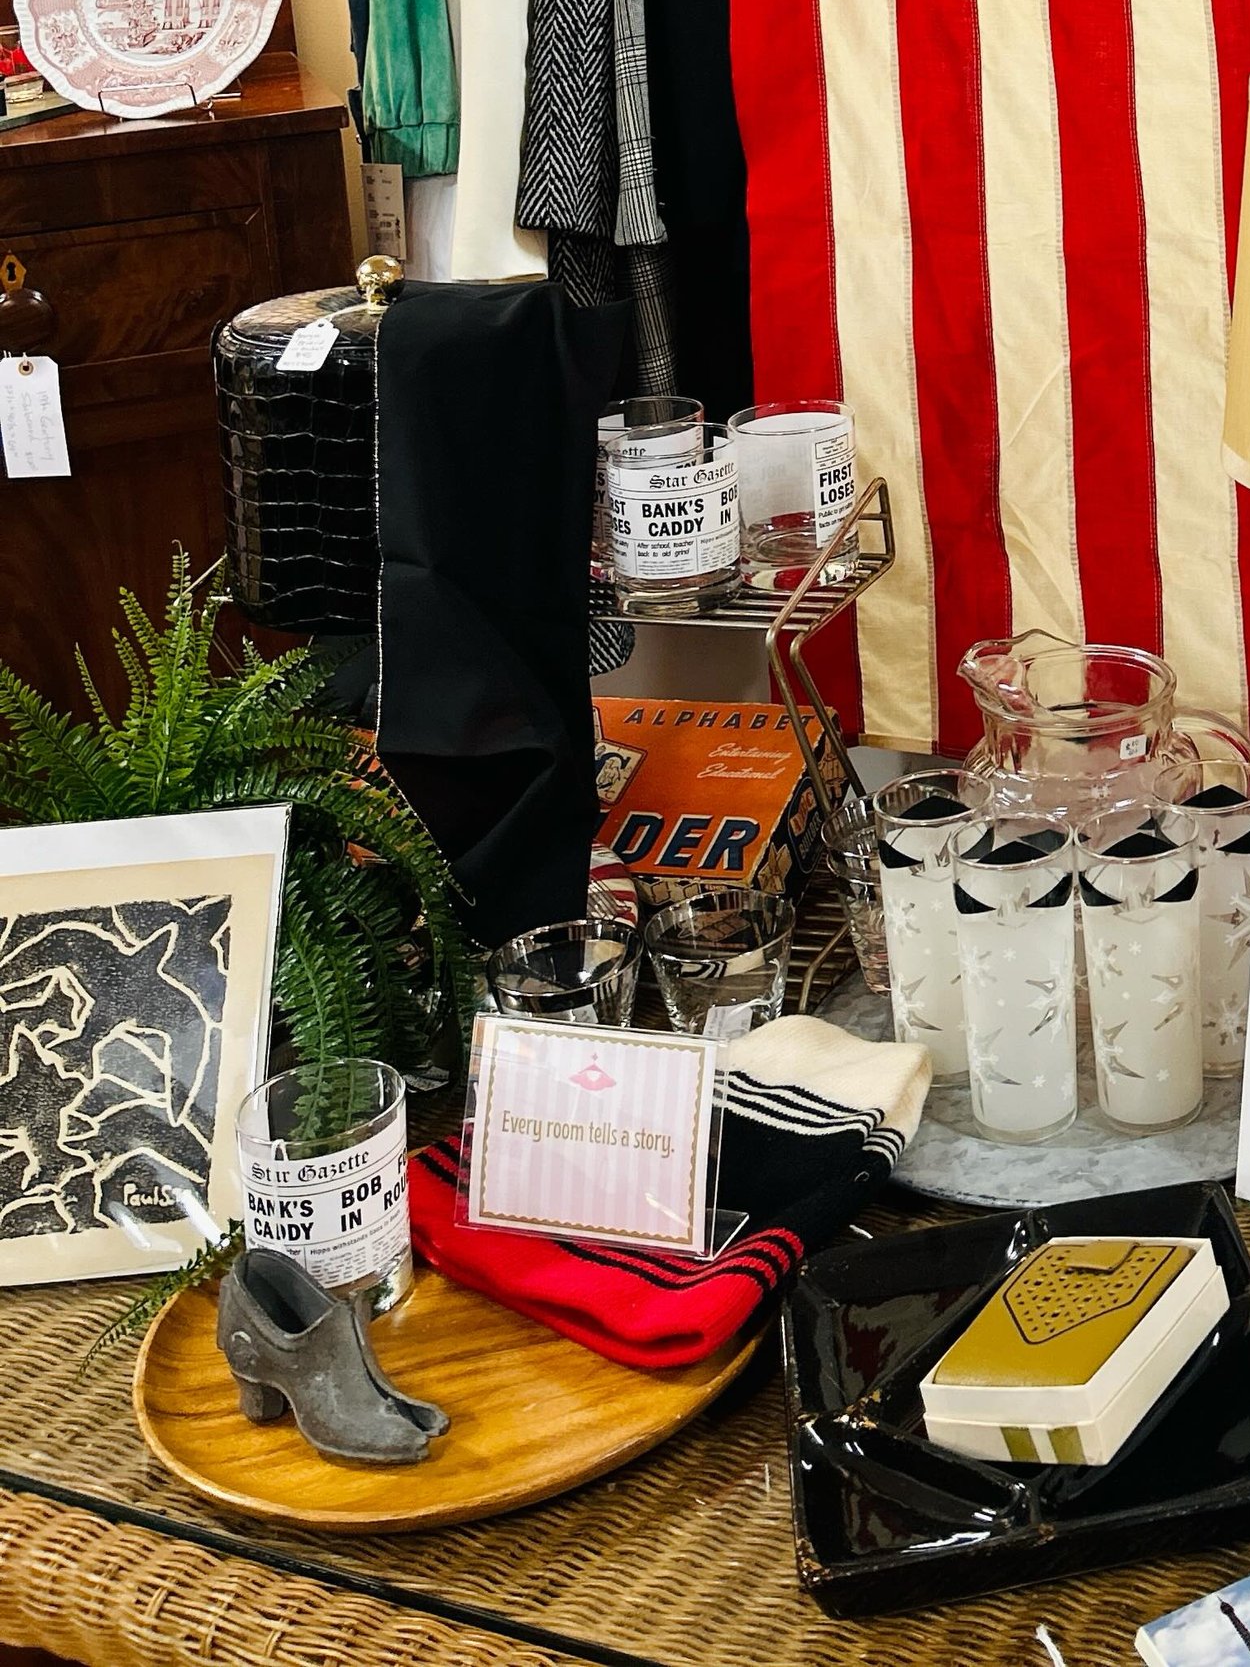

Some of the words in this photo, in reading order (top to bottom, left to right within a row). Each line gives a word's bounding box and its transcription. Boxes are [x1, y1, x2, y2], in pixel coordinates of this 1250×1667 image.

[649, 475, 688, 489] Star
[693, 462, 735, 485] Gazette
[819, 463, 853, 488] FIRST
[820, 480, 855, 506] LOSES
[641, 498, 705, 519] BANK'S
[720, 508, 731, 525] IN
[648, 517, 705, 537] CADDY
[623, 707, 815, 731] ALPHABET
[592, 809, 760, 871] DER
[501, 1110, 542, 1142] Every
[546, 1121, 584, 1142] room
[589, 1121, 618, 1146] tells
[621, 1130, 629, 1147] a
[633, 1127, 675, 1159] story.
[298, 1150, 370, 1183] Gazette
[341, 1174, 383, 1210] BOB
[247, 1192, 314, 1219] BANK'S
[340, 1209, 363, 1233] IN
[310, 1246, 332, 1256] Hippo
